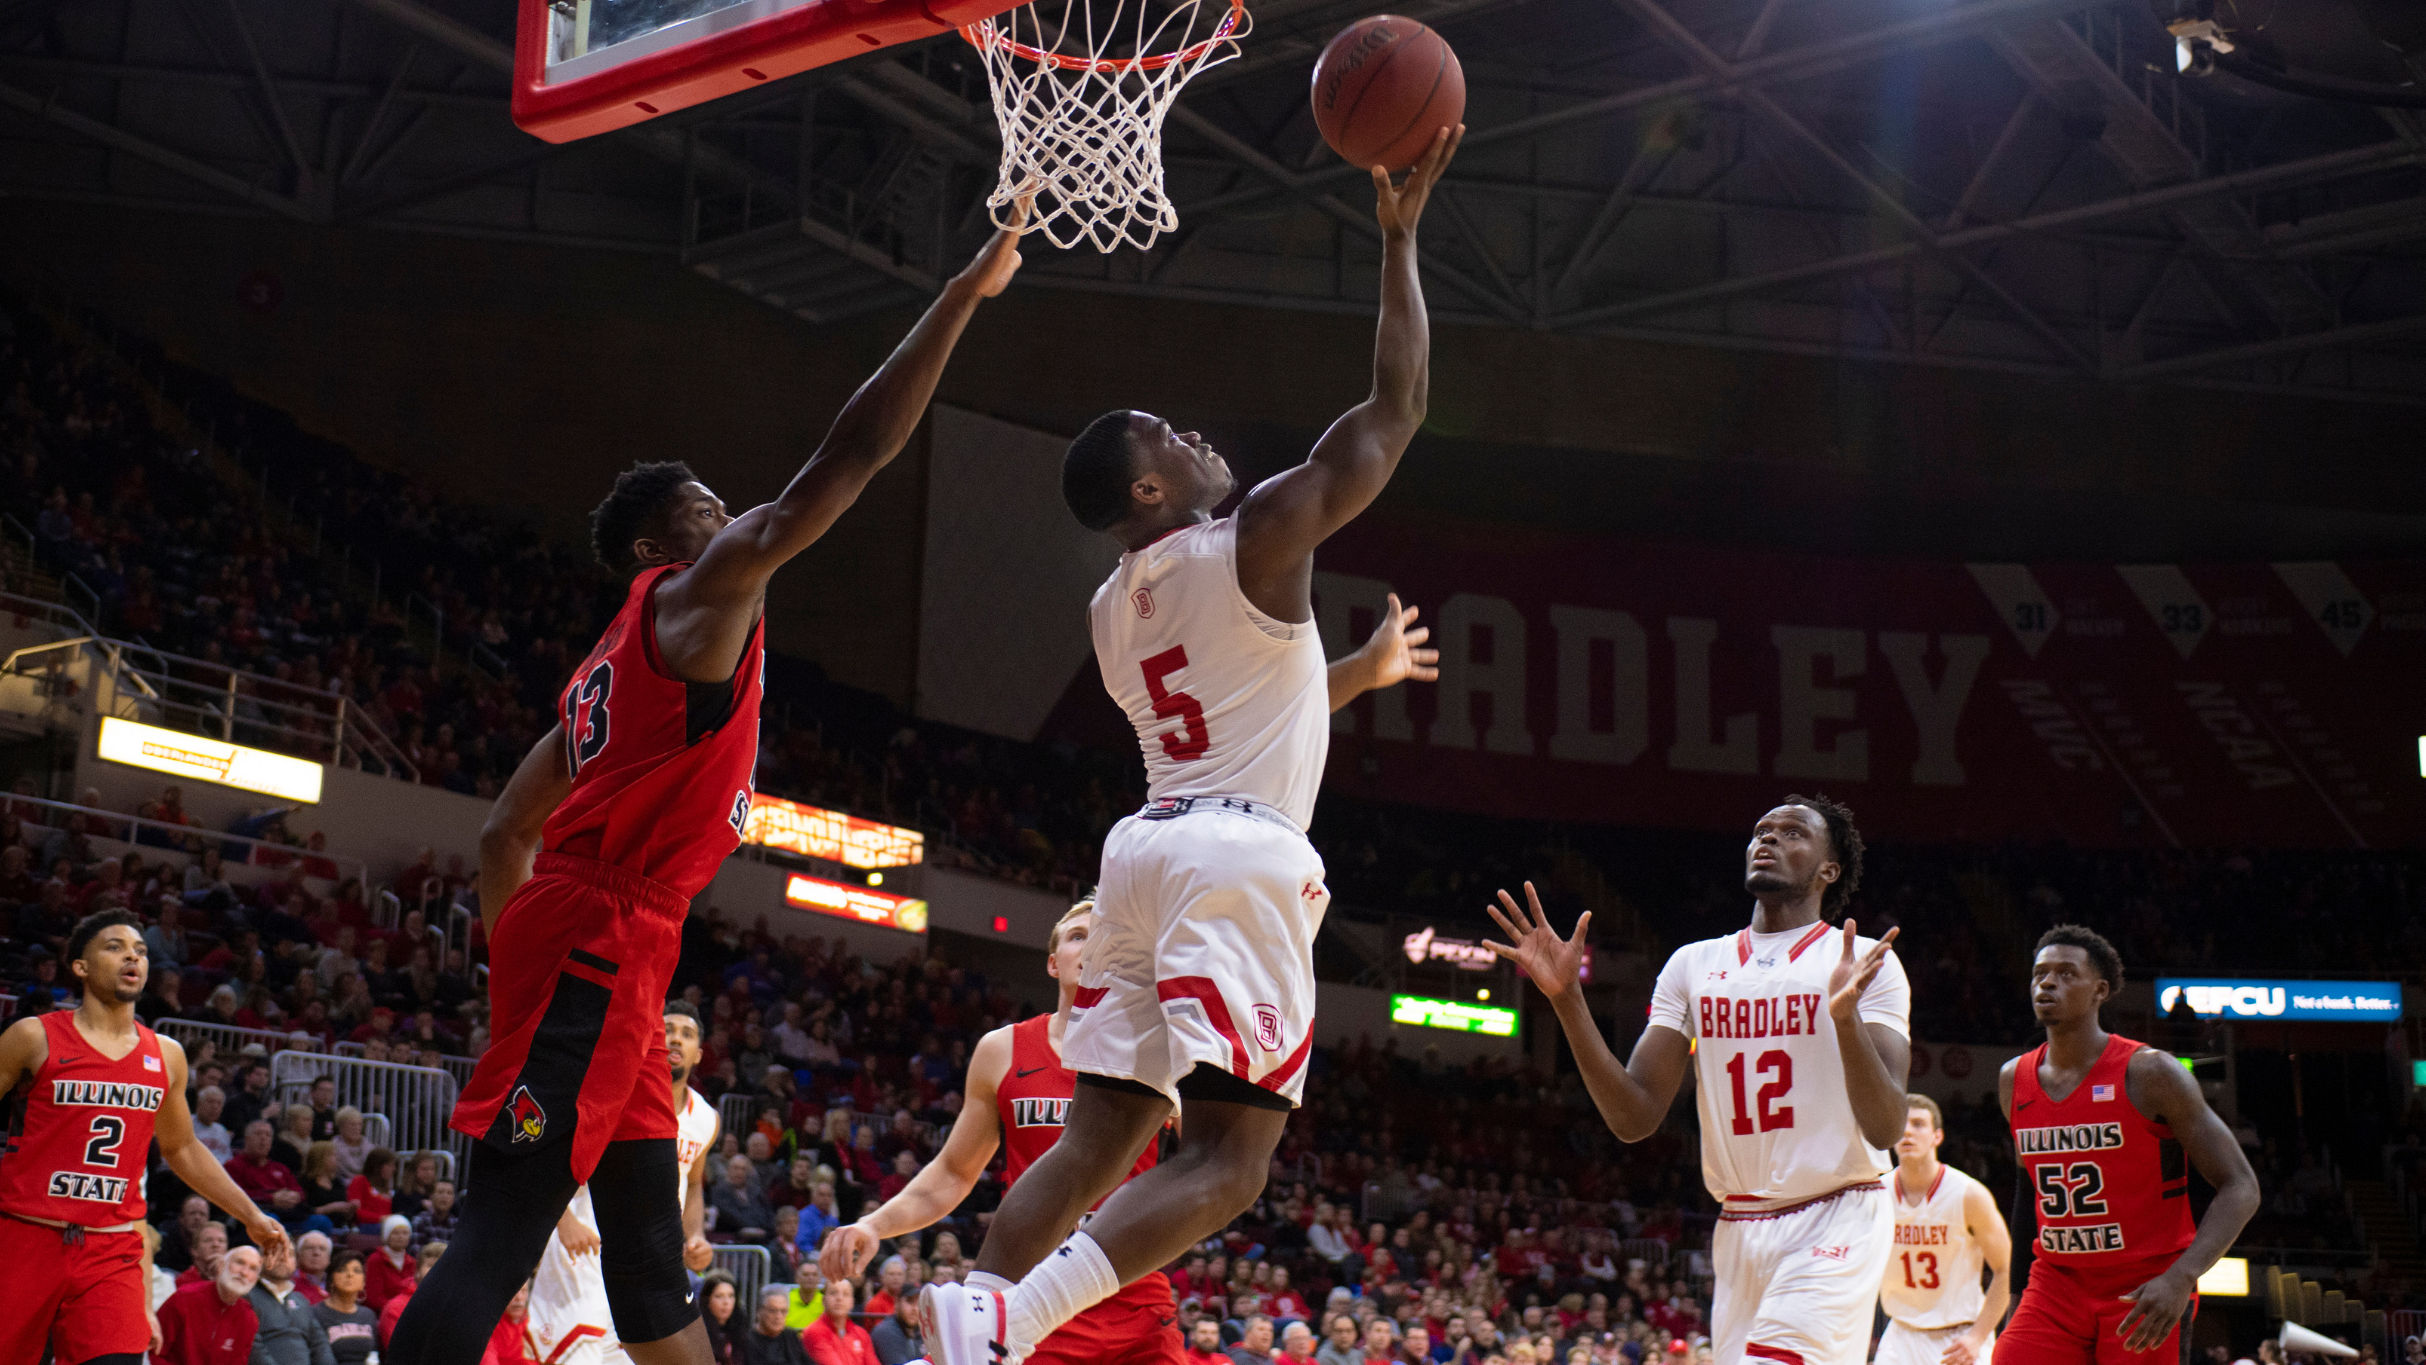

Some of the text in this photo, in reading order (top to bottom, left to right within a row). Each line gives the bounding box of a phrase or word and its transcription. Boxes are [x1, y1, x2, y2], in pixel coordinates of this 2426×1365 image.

[2015, 604, 2045, 632] 31
[2162, 605, 2201, 633] 33
[2320, 601, 2362, 630] 45
[566, 659, 614, 784] 13
[1139, 643, 1212, 761] 5
[2174, 681, 2297, 790] NCAA
[1700, 994, 1821, 1039] BRADLEY
[52, 1080, 164, 1112] ILLINOIS
[1726, 1049, 1794, 1136] 12
[83, 1114, 126, 1168] 2
[2015, 1121, 2124, 1155] ILLINOIS
[2035, 1161, 2109, 1218] 52
[2040, 1222, 2125, 1254] STATE
[1900, 1250, 1940, 1290] 13
